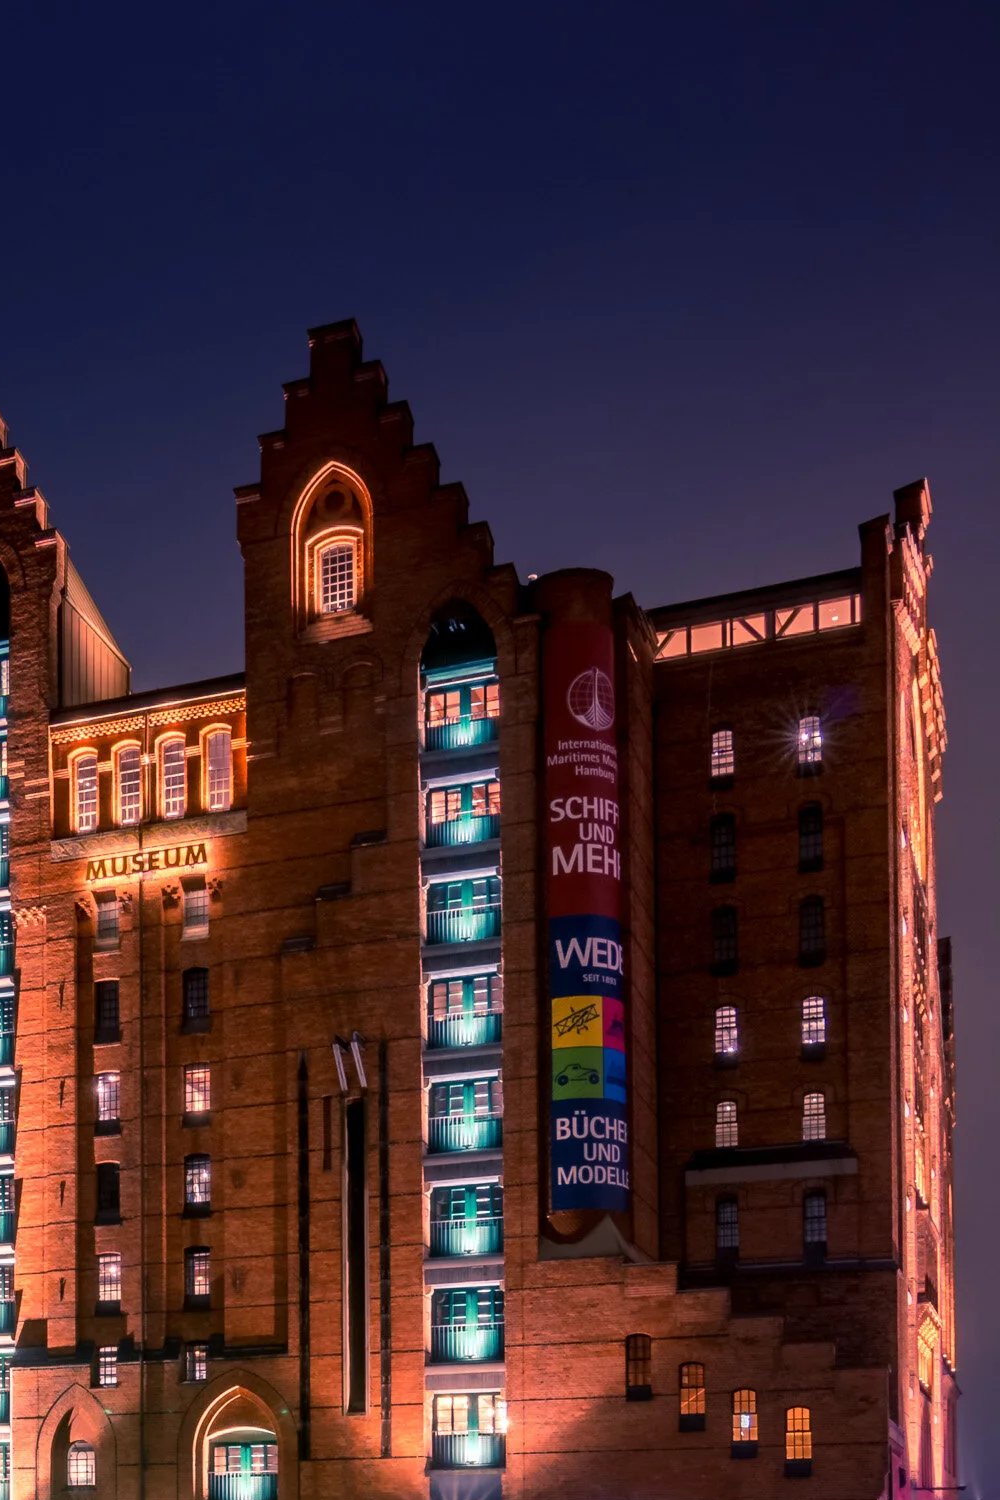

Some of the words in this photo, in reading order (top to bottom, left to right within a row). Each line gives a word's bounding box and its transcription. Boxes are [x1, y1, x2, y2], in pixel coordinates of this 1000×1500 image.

[547, 752, 600, 767] Maritimes
[575, 765, 615, 784] Hamburg
[550, 796, 619, 825] SCHIFF
[579, 822, 615, 844] UND
[86, 844, 207, 880] MUSEUM
[582, 973, 599, 982] SEIT
[583, 1142, 620, 1163] UND
